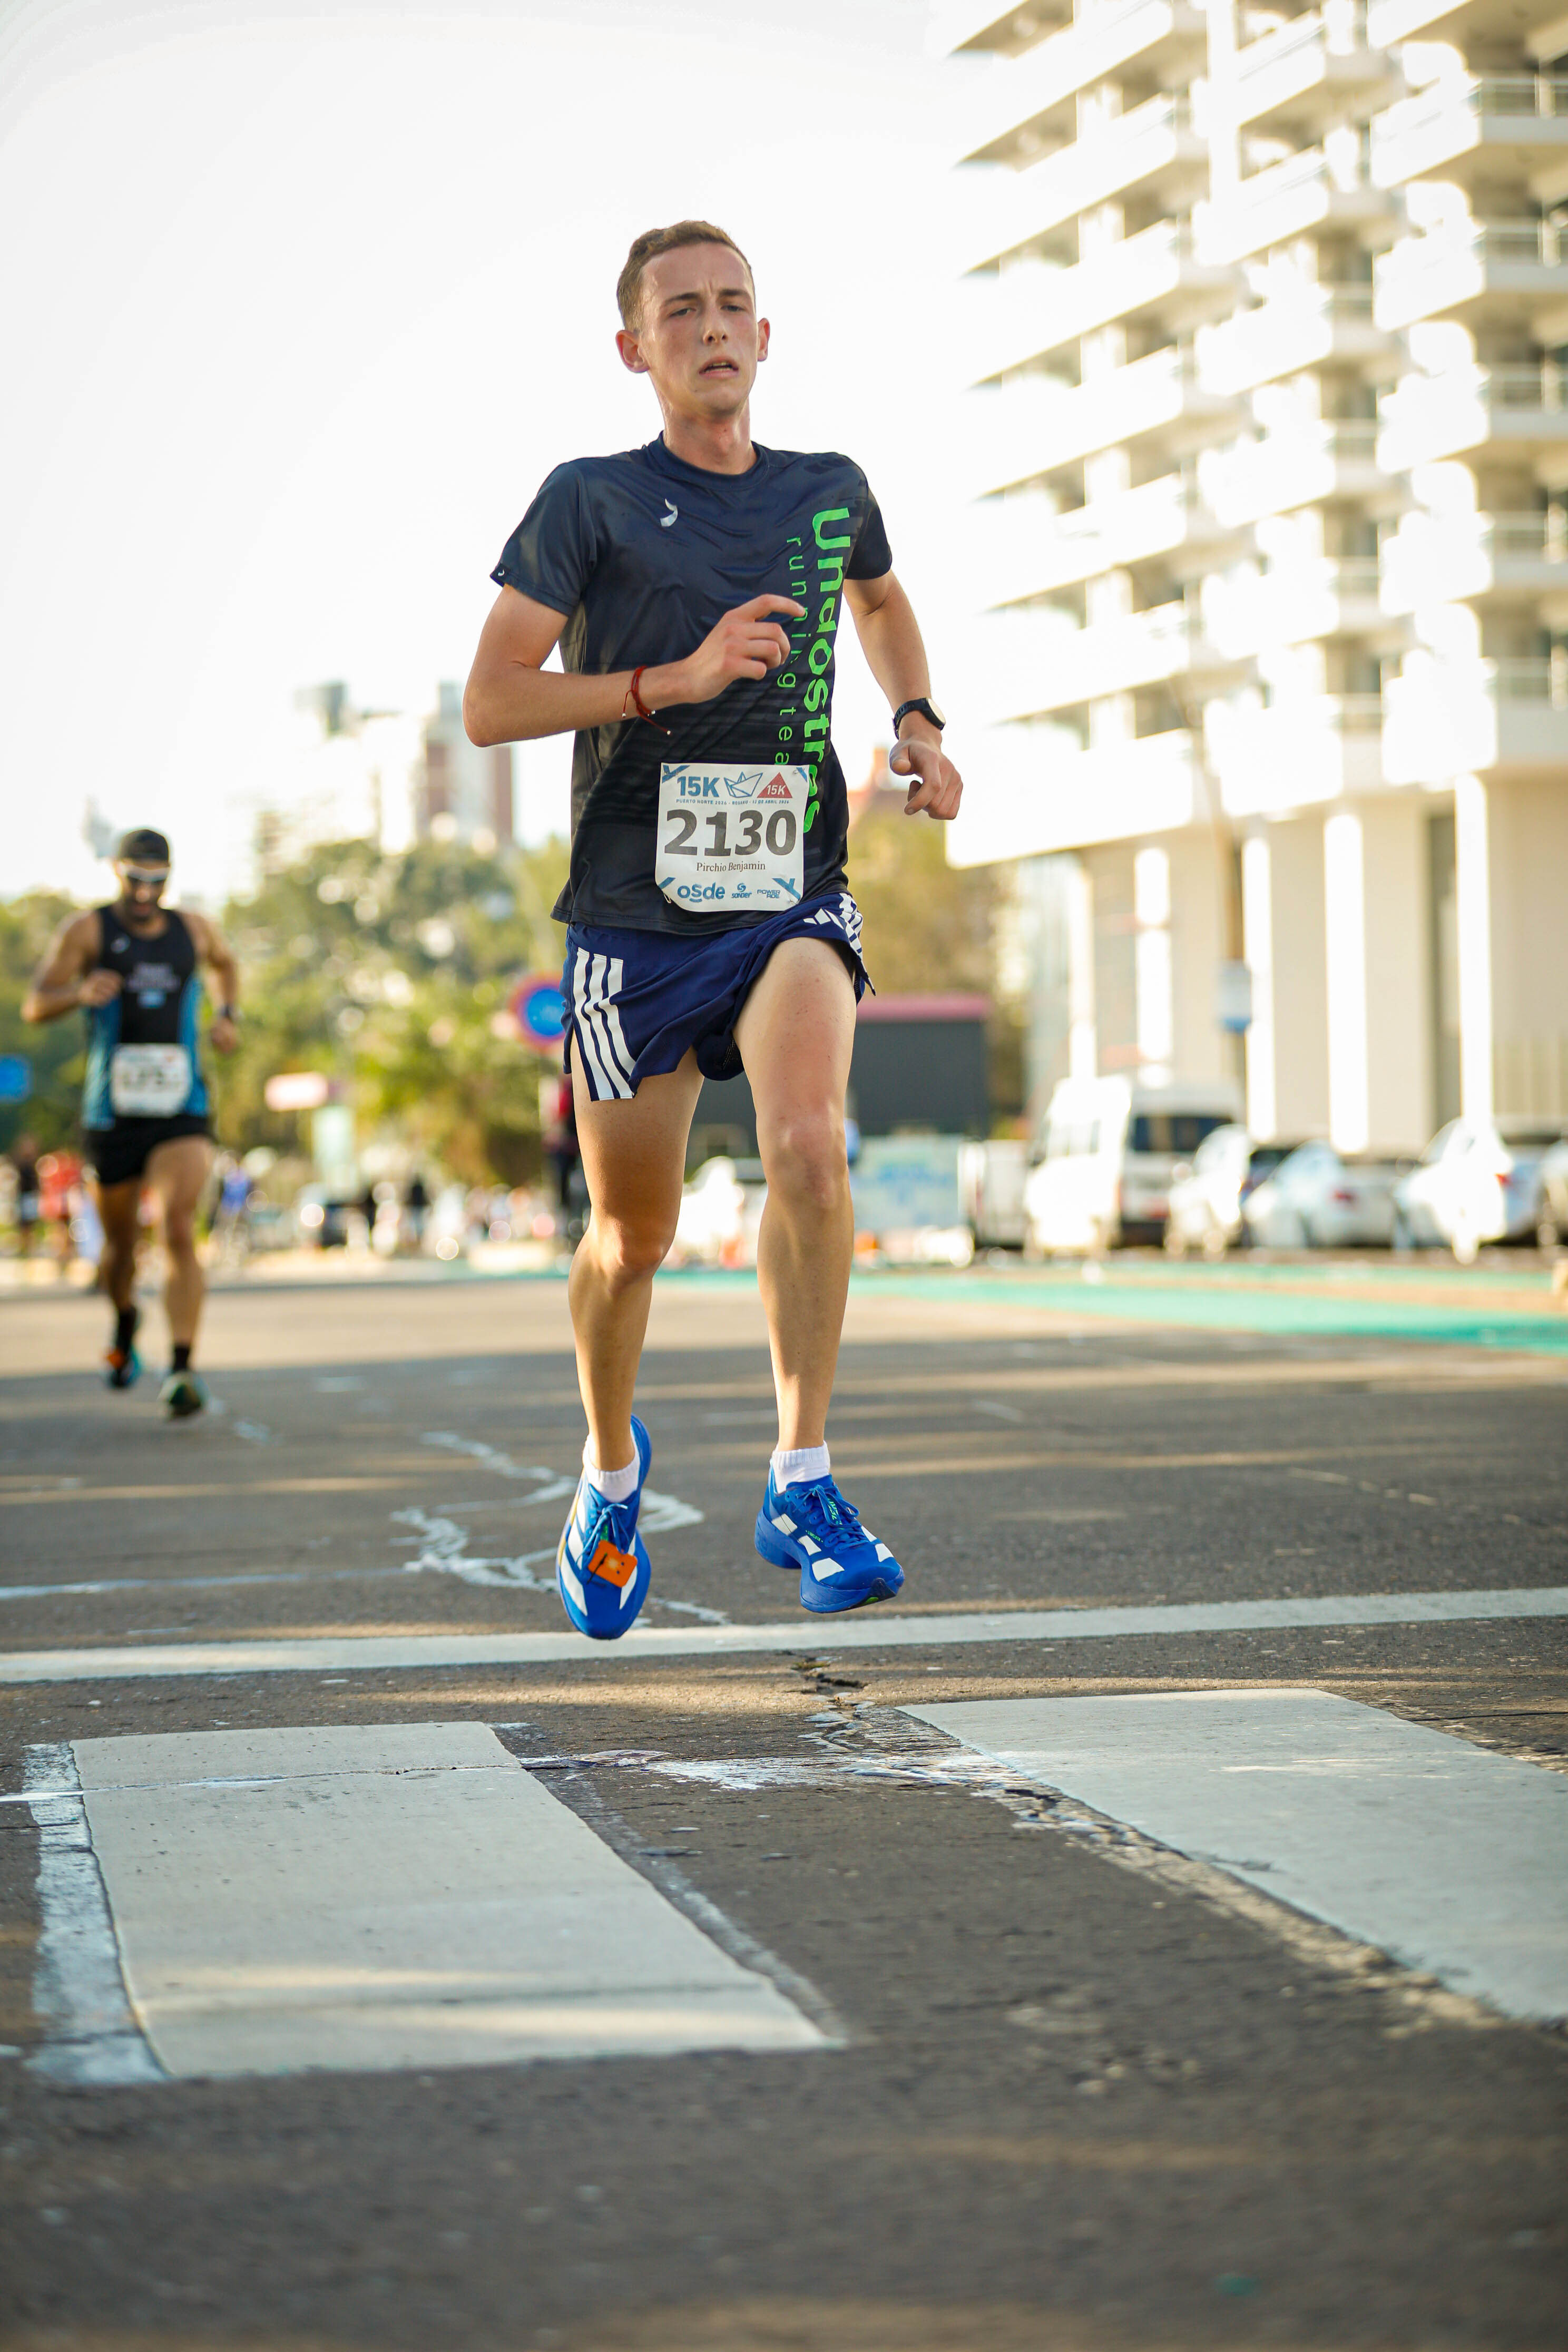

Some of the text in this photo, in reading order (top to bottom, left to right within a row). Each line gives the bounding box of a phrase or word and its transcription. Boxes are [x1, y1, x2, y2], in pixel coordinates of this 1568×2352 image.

[775, 707, 796, 765] tea
[677, 776, 720, 798] 15K
[767, 785, 786, 796] 15K
[664, 809, 797, 856] 2130
[697, 861, 766, 872] Pirchio Benjamin
[677, 882, 726, 900] osde
